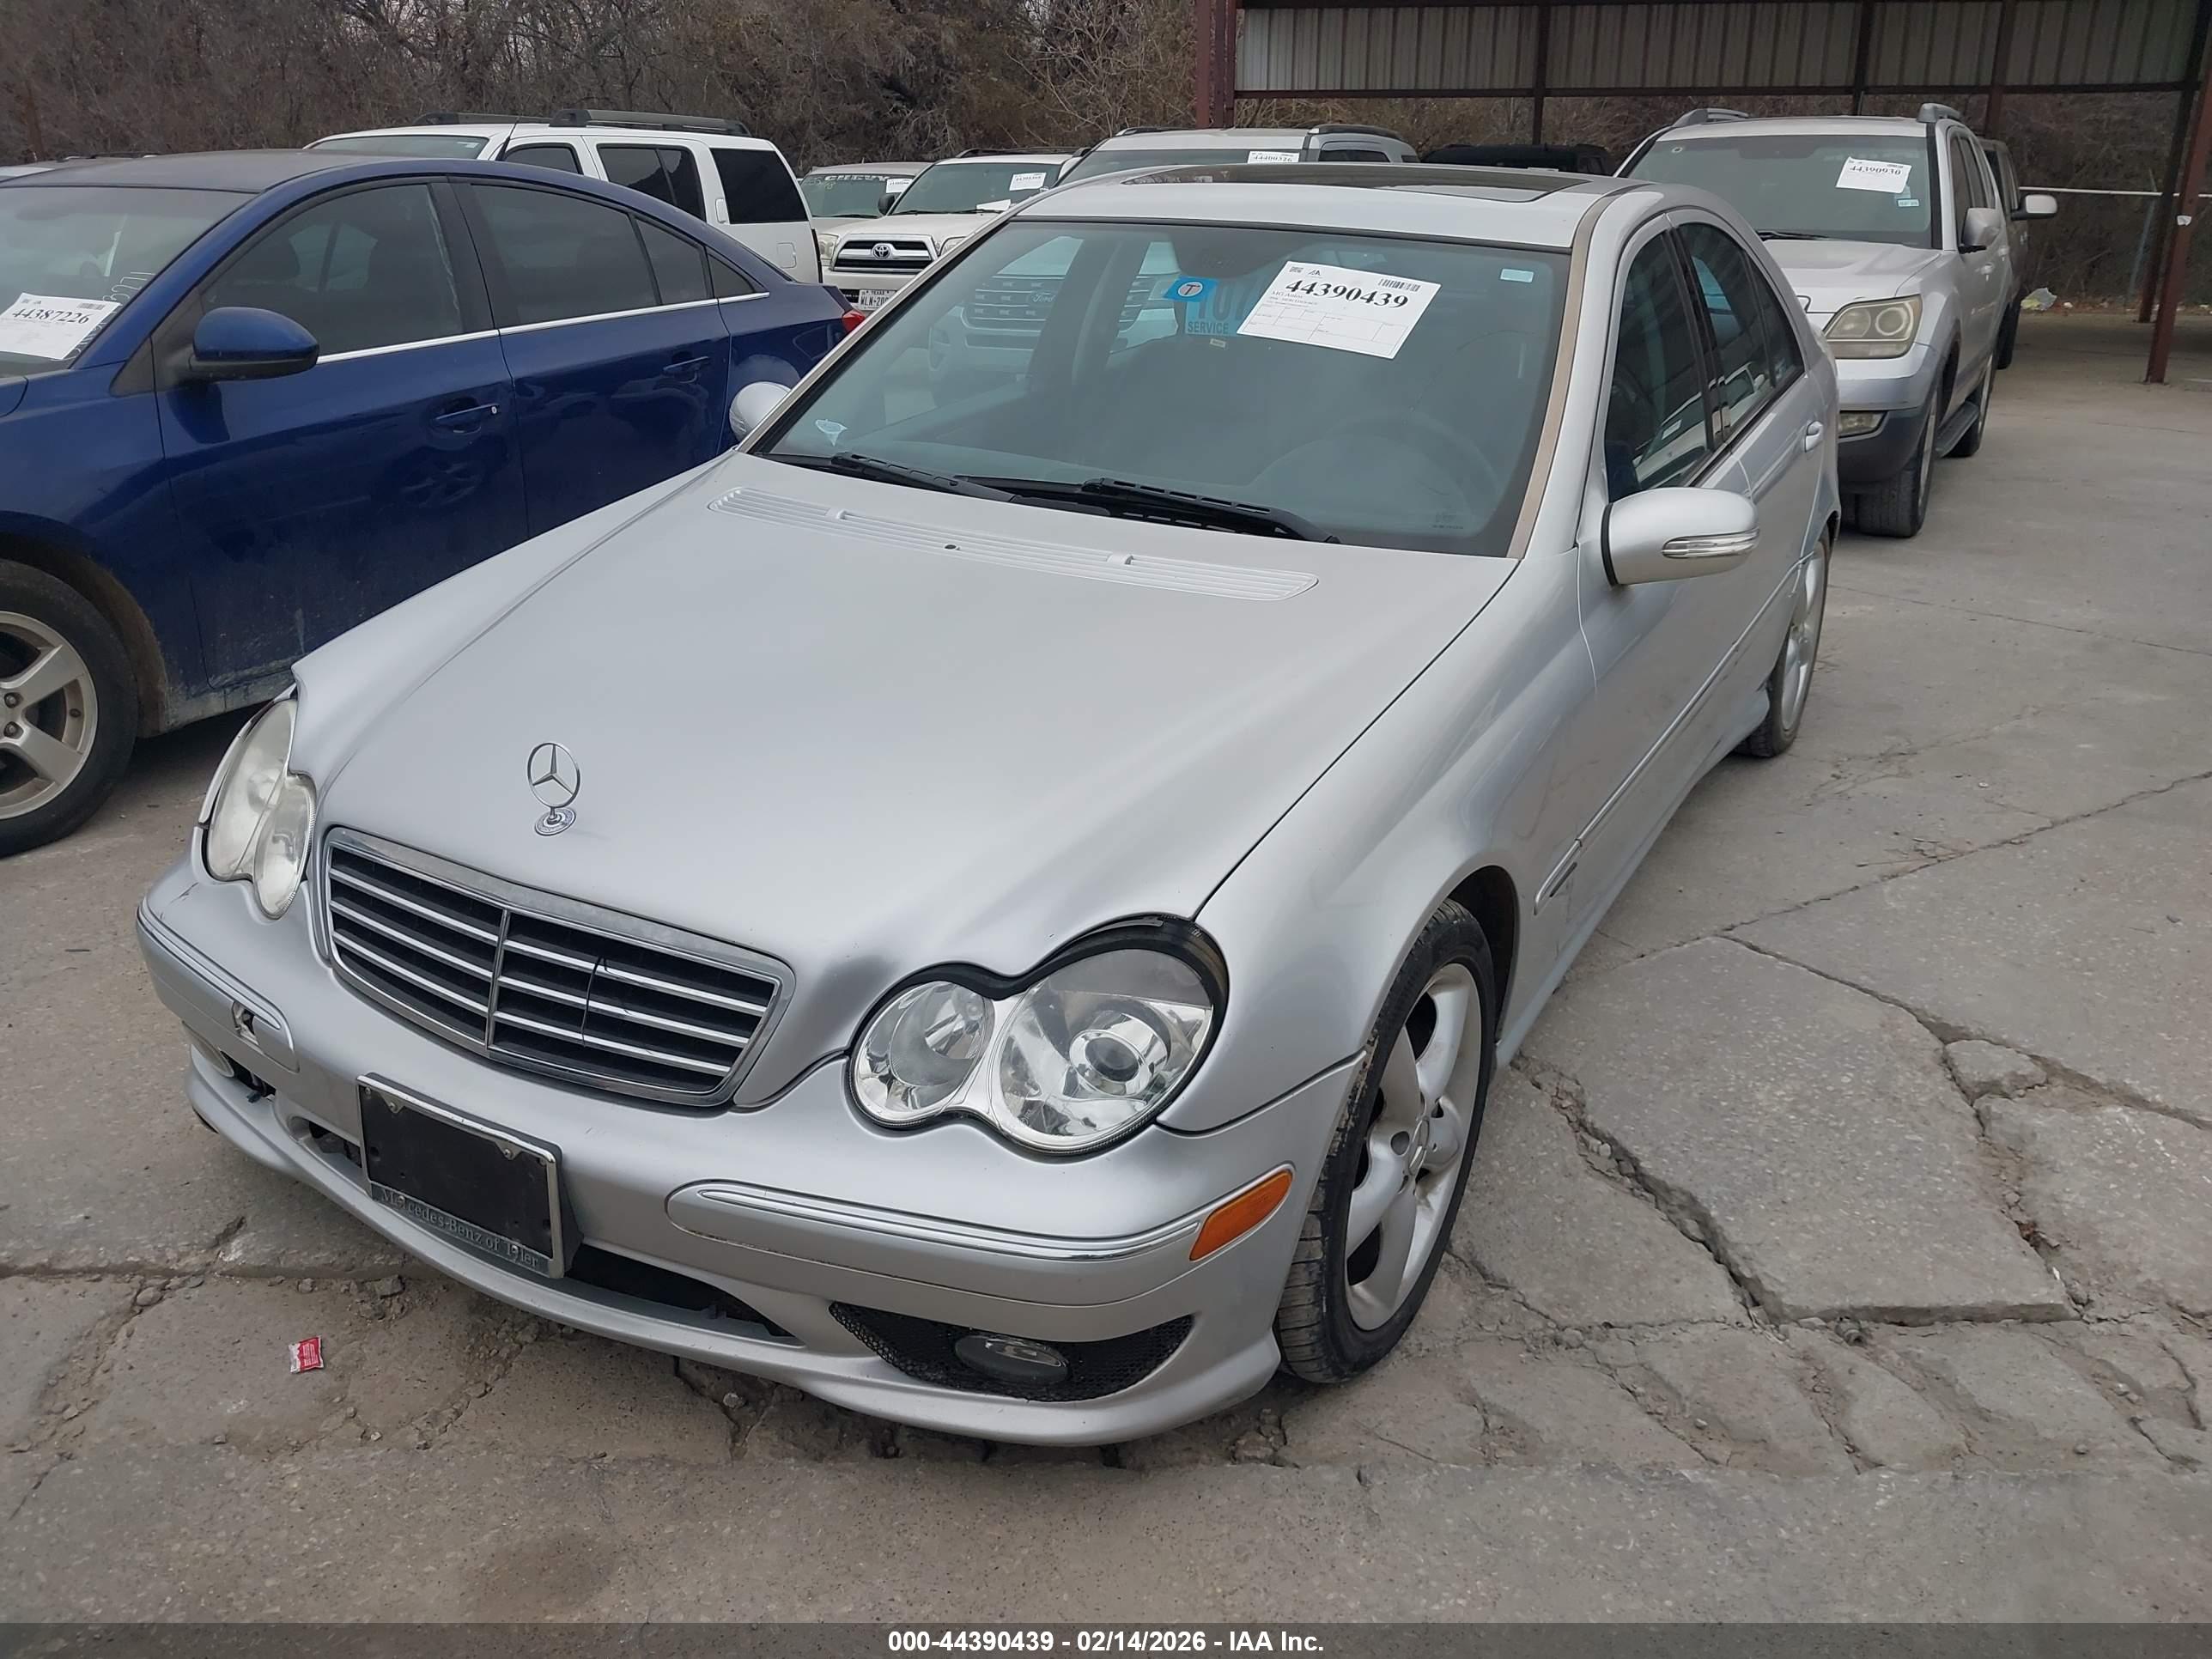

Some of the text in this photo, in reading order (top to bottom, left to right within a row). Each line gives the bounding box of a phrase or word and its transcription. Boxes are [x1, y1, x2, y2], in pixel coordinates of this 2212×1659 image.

[1285, 280, 1408, 308] 44390439
[12, 308, 92, 325] 44387226
[1188, 321, 1229, 334] SERVICE
[381, 1188, 483, 1245] Mcedes-Benz
[485, 1236, 501, 1251] of
